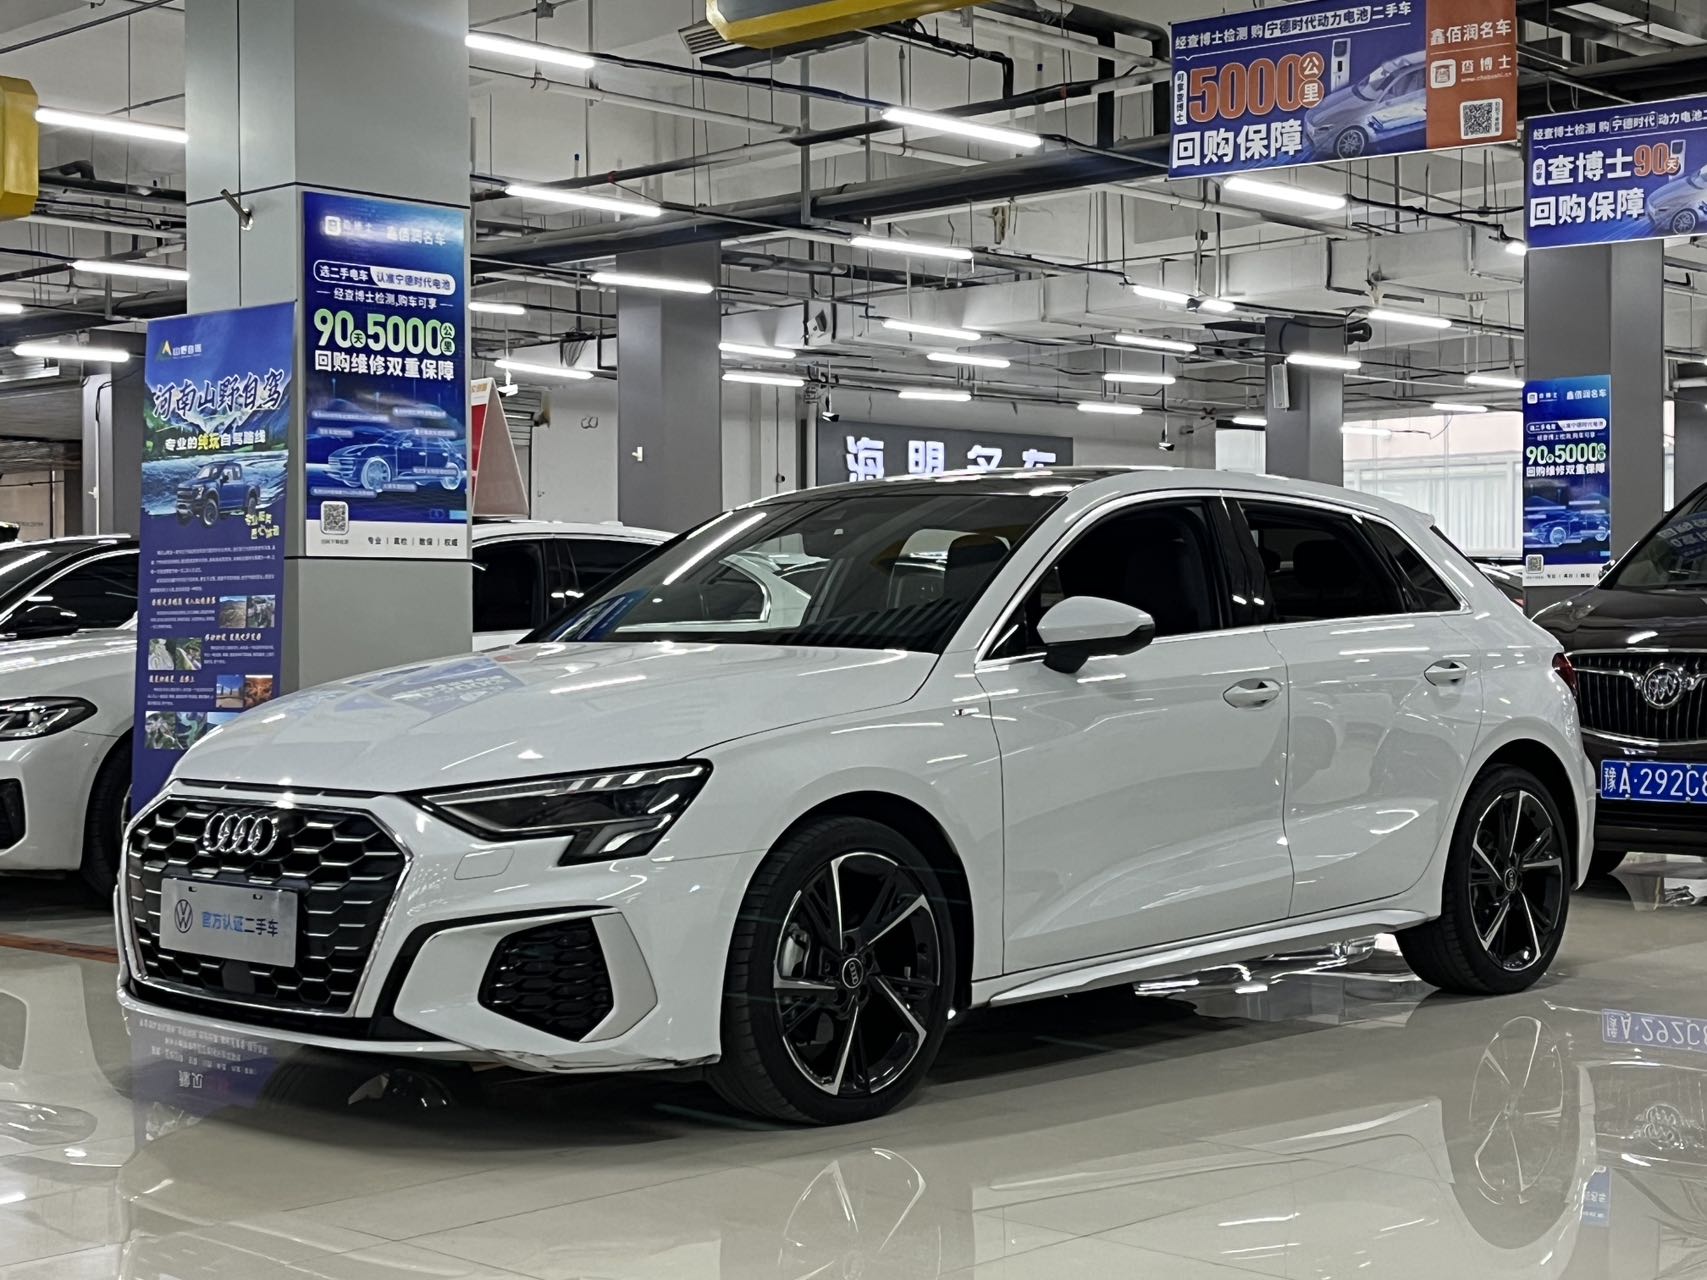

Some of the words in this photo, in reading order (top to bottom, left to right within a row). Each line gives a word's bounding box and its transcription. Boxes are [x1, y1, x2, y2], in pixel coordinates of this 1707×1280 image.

[1175, 26, 1248, 50] 经查博士检测
[1430, 18, 1512, 46] 鑫佰润名车
[1461, 55, 1511, 74] 查博士
[1173, 119, 1302, 169] 回购保障
[1530, 187, 1645, 228] 回购保障
[314, 350, 455, 381] 回购维修双重保障
[153, 368, 284, 421] 河南山野自驾
[202, 911, 278, 937] 官方认证二手车
